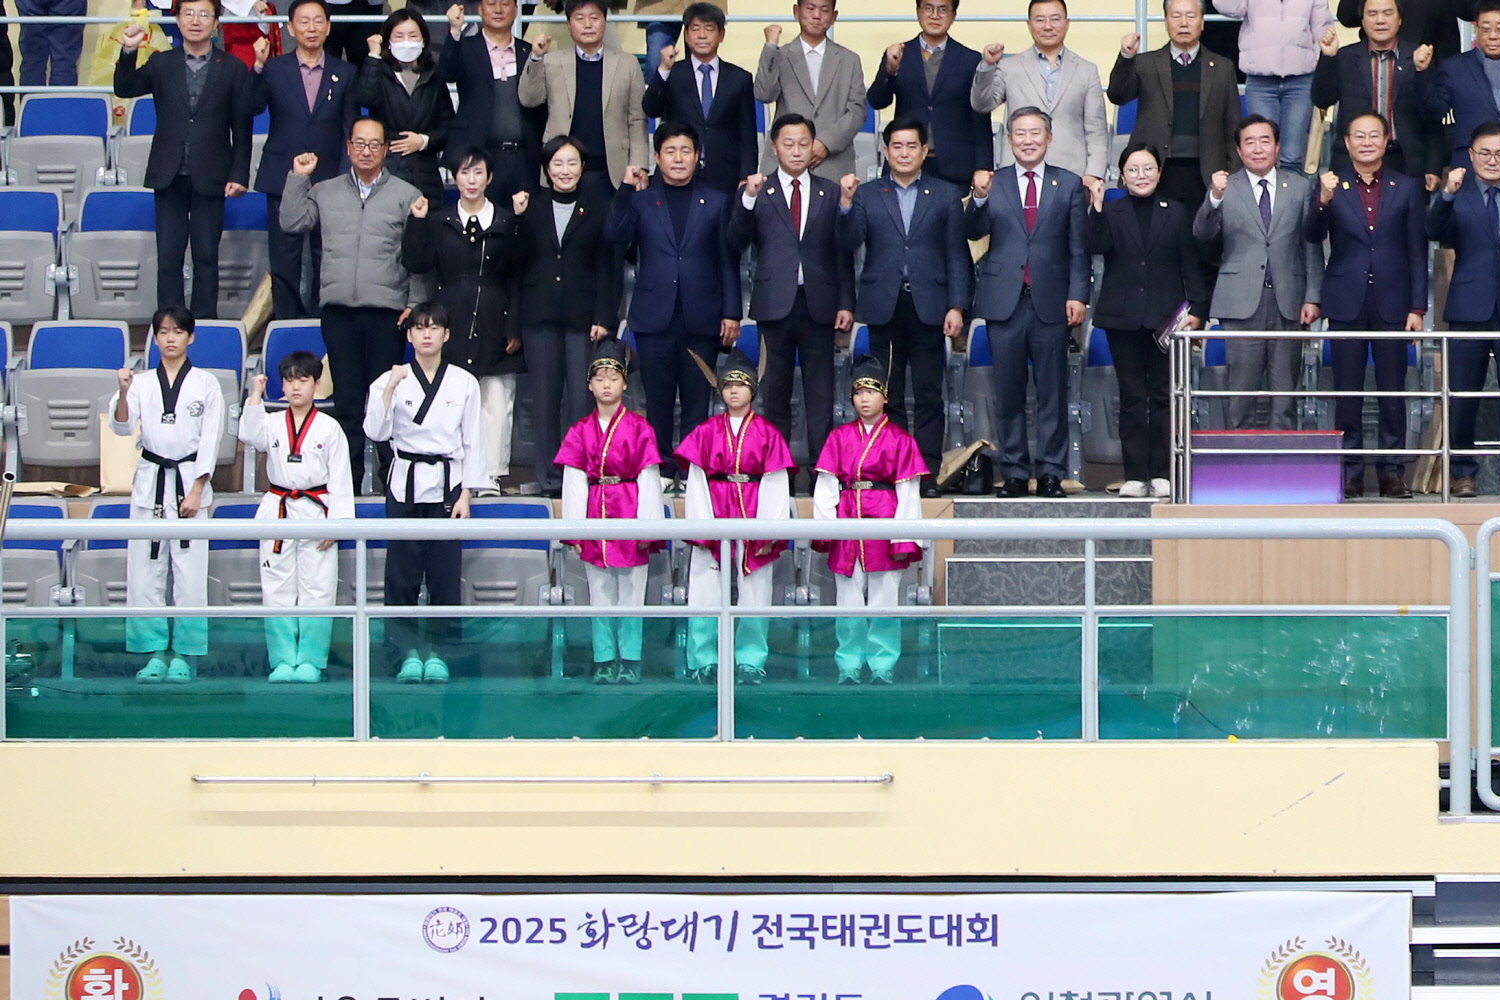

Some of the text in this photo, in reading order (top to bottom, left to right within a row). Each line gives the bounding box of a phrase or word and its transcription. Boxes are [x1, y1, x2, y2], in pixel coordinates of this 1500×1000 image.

[479, 908, 999, 952] 2025 화랑대기 전국태권도대회
